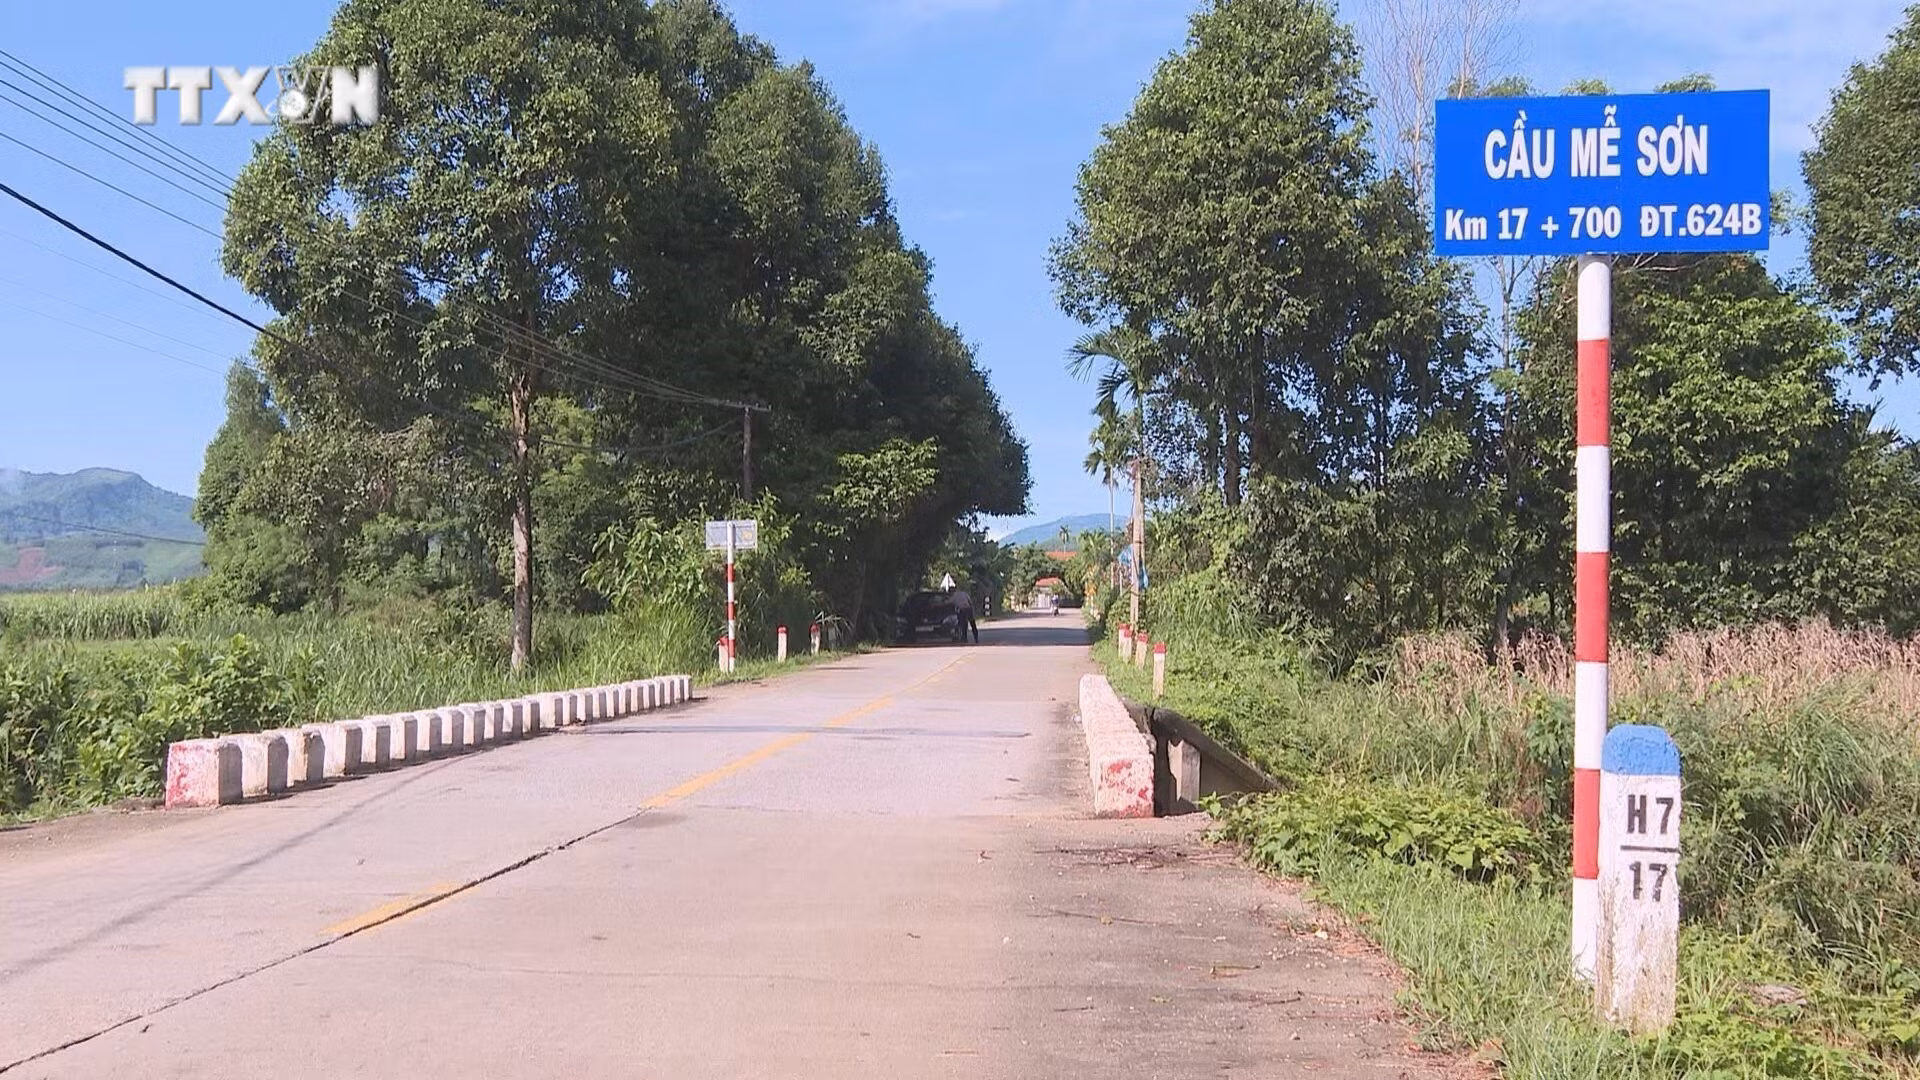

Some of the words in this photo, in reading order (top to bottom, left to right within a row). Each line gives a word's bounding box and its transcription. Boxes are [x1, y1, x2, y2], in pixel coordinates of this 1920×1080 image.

[1484, 110, 1555, 179] CẦU
[1571, 104, 1621, 177] MỄ
[1637, 115, 1708, 176] SƠN
[1445, 209, 1487, 240] Km
[1498, 208, 1528, 239] 17
[1541, 216, 1559, 239] +
[1569, 206, 1621, 238] 700
[1640, 203, 1761, 237] ĐT.624B
[1629, 861, 1668, 902] 17
